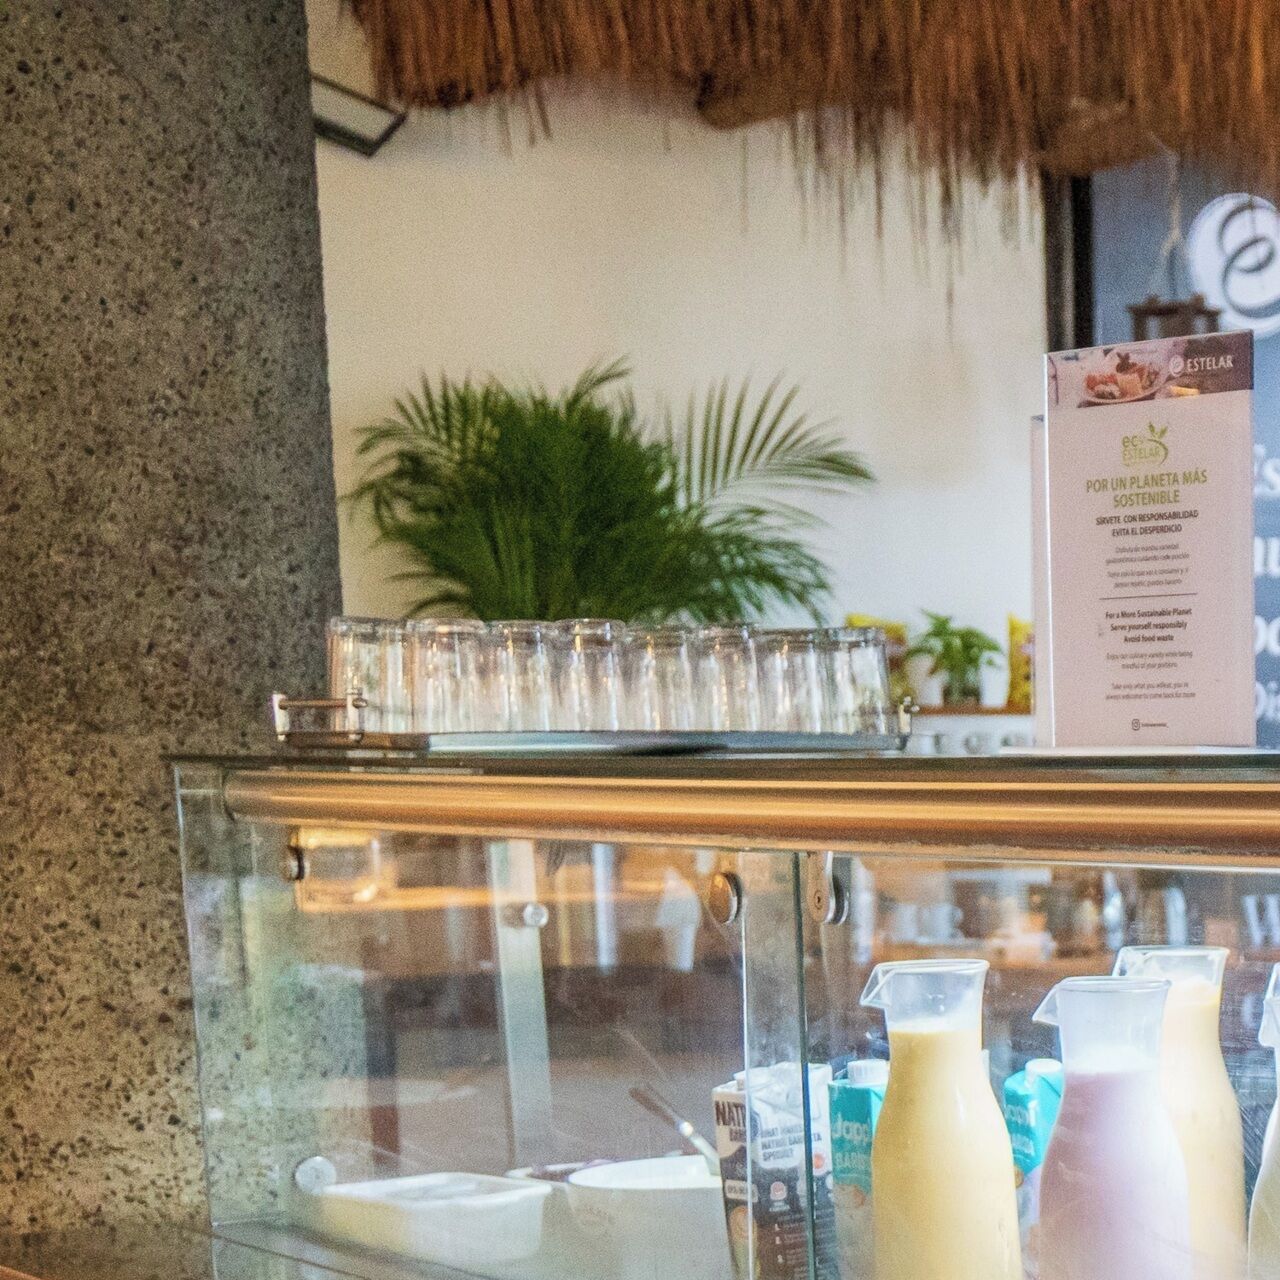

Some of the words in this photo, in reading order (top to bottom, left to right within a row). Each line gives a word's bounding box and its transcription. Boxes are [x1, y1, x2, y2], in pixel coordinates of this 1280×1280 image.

[1187, 355, 1234, 372] ESTELAR
[1086, 479, 1108, 493] POR
[1111, 477, 1127, 491] UN
[1130, 472, 1180, 489] PLANETA
[1182, 467, 1207, 485] MÁS
[1113, 490, 1180, 508] SOSTENIBLE
[1123, 514, 1138, 523] CON
[1138, 510, 1199, 522] RESPONSABILIDAD
[1112, 527, 1130, 537] EVITA
[1131, 527, 1138, 536] EL
[1140, 524, 1183, 536] DESPERDICIO
[1105, 611, 1115, 619] For
[1137, 608, 1171, 618] Sustainable
[1172, 608, 1192, 616] Planet
[1110, 623, 1127, 631] Serve
[1128, 621, 1152, 632] yourself
[1153, 620, 1188, 630] responsibly
[1123, 635, 1141, 643] Avoid
[1142, 634, 1155, 642] food
[1156, 634, 1174, 642] waste
